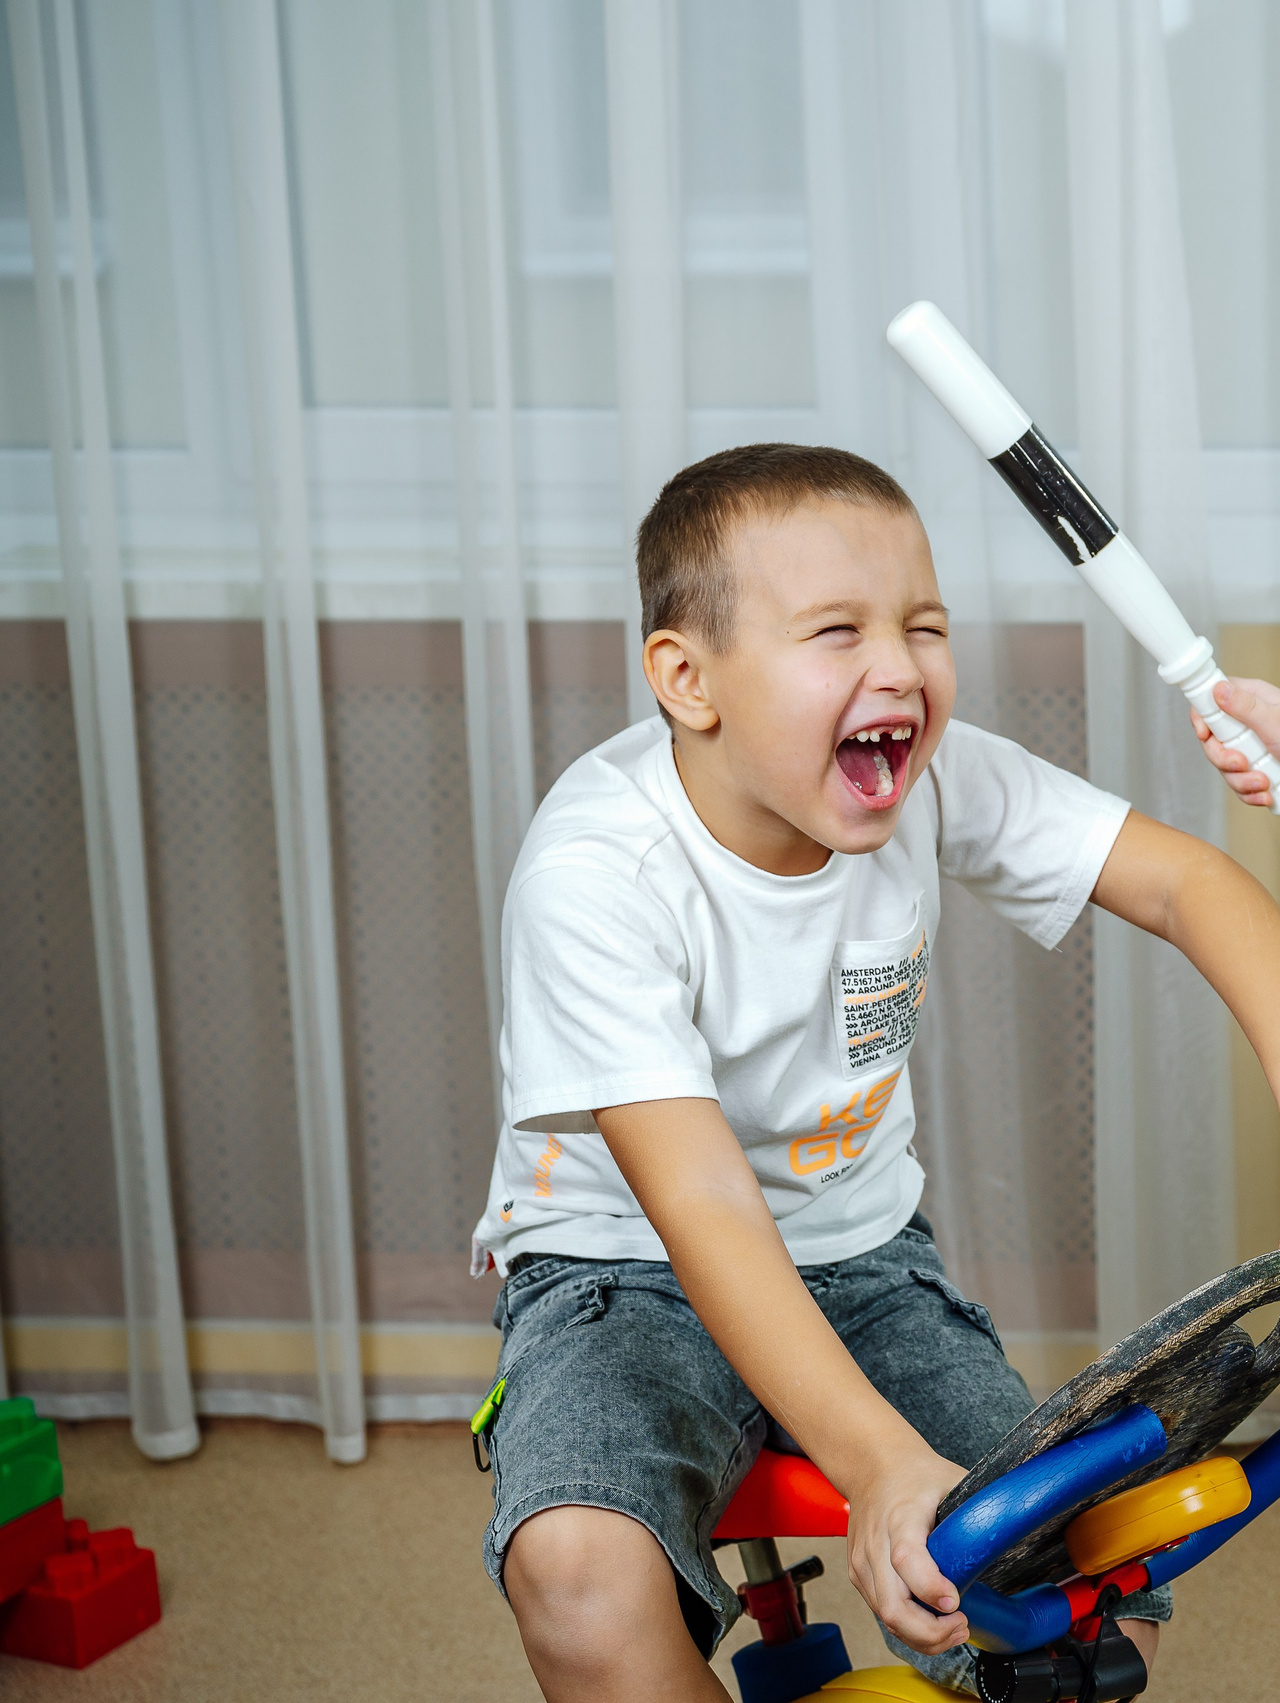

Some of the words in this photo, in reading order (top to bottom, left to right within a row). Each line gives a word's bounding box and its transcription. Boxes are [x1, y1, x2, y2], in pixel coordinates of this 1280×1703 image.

[841, 965, 894, 977] AMSTERDAM
[842, 978, 872, 986] 47.5167
[858, 981, 895, 994] AROUND
[898, 972, 910, 984] THE
[845, 994, 875, 1004] PORTO
[846, 1010, 877, 1021] 45.4667
[879, 1007, 885, 1015] N
[861, 1010, 896, 1027] AROUND
[898, 1002, 910, 1013] THE
[848, 1028, 868, 1038] SALT
[870, 1020, 889, 1032] LAKE
[848, 1036, 887, 1053] MOSCOW
[863, 1038, 896, 1056] AROUND
[850, 1053, 881, 1068] VIENNA
[820, 1170, 840, 1183] LOOK
